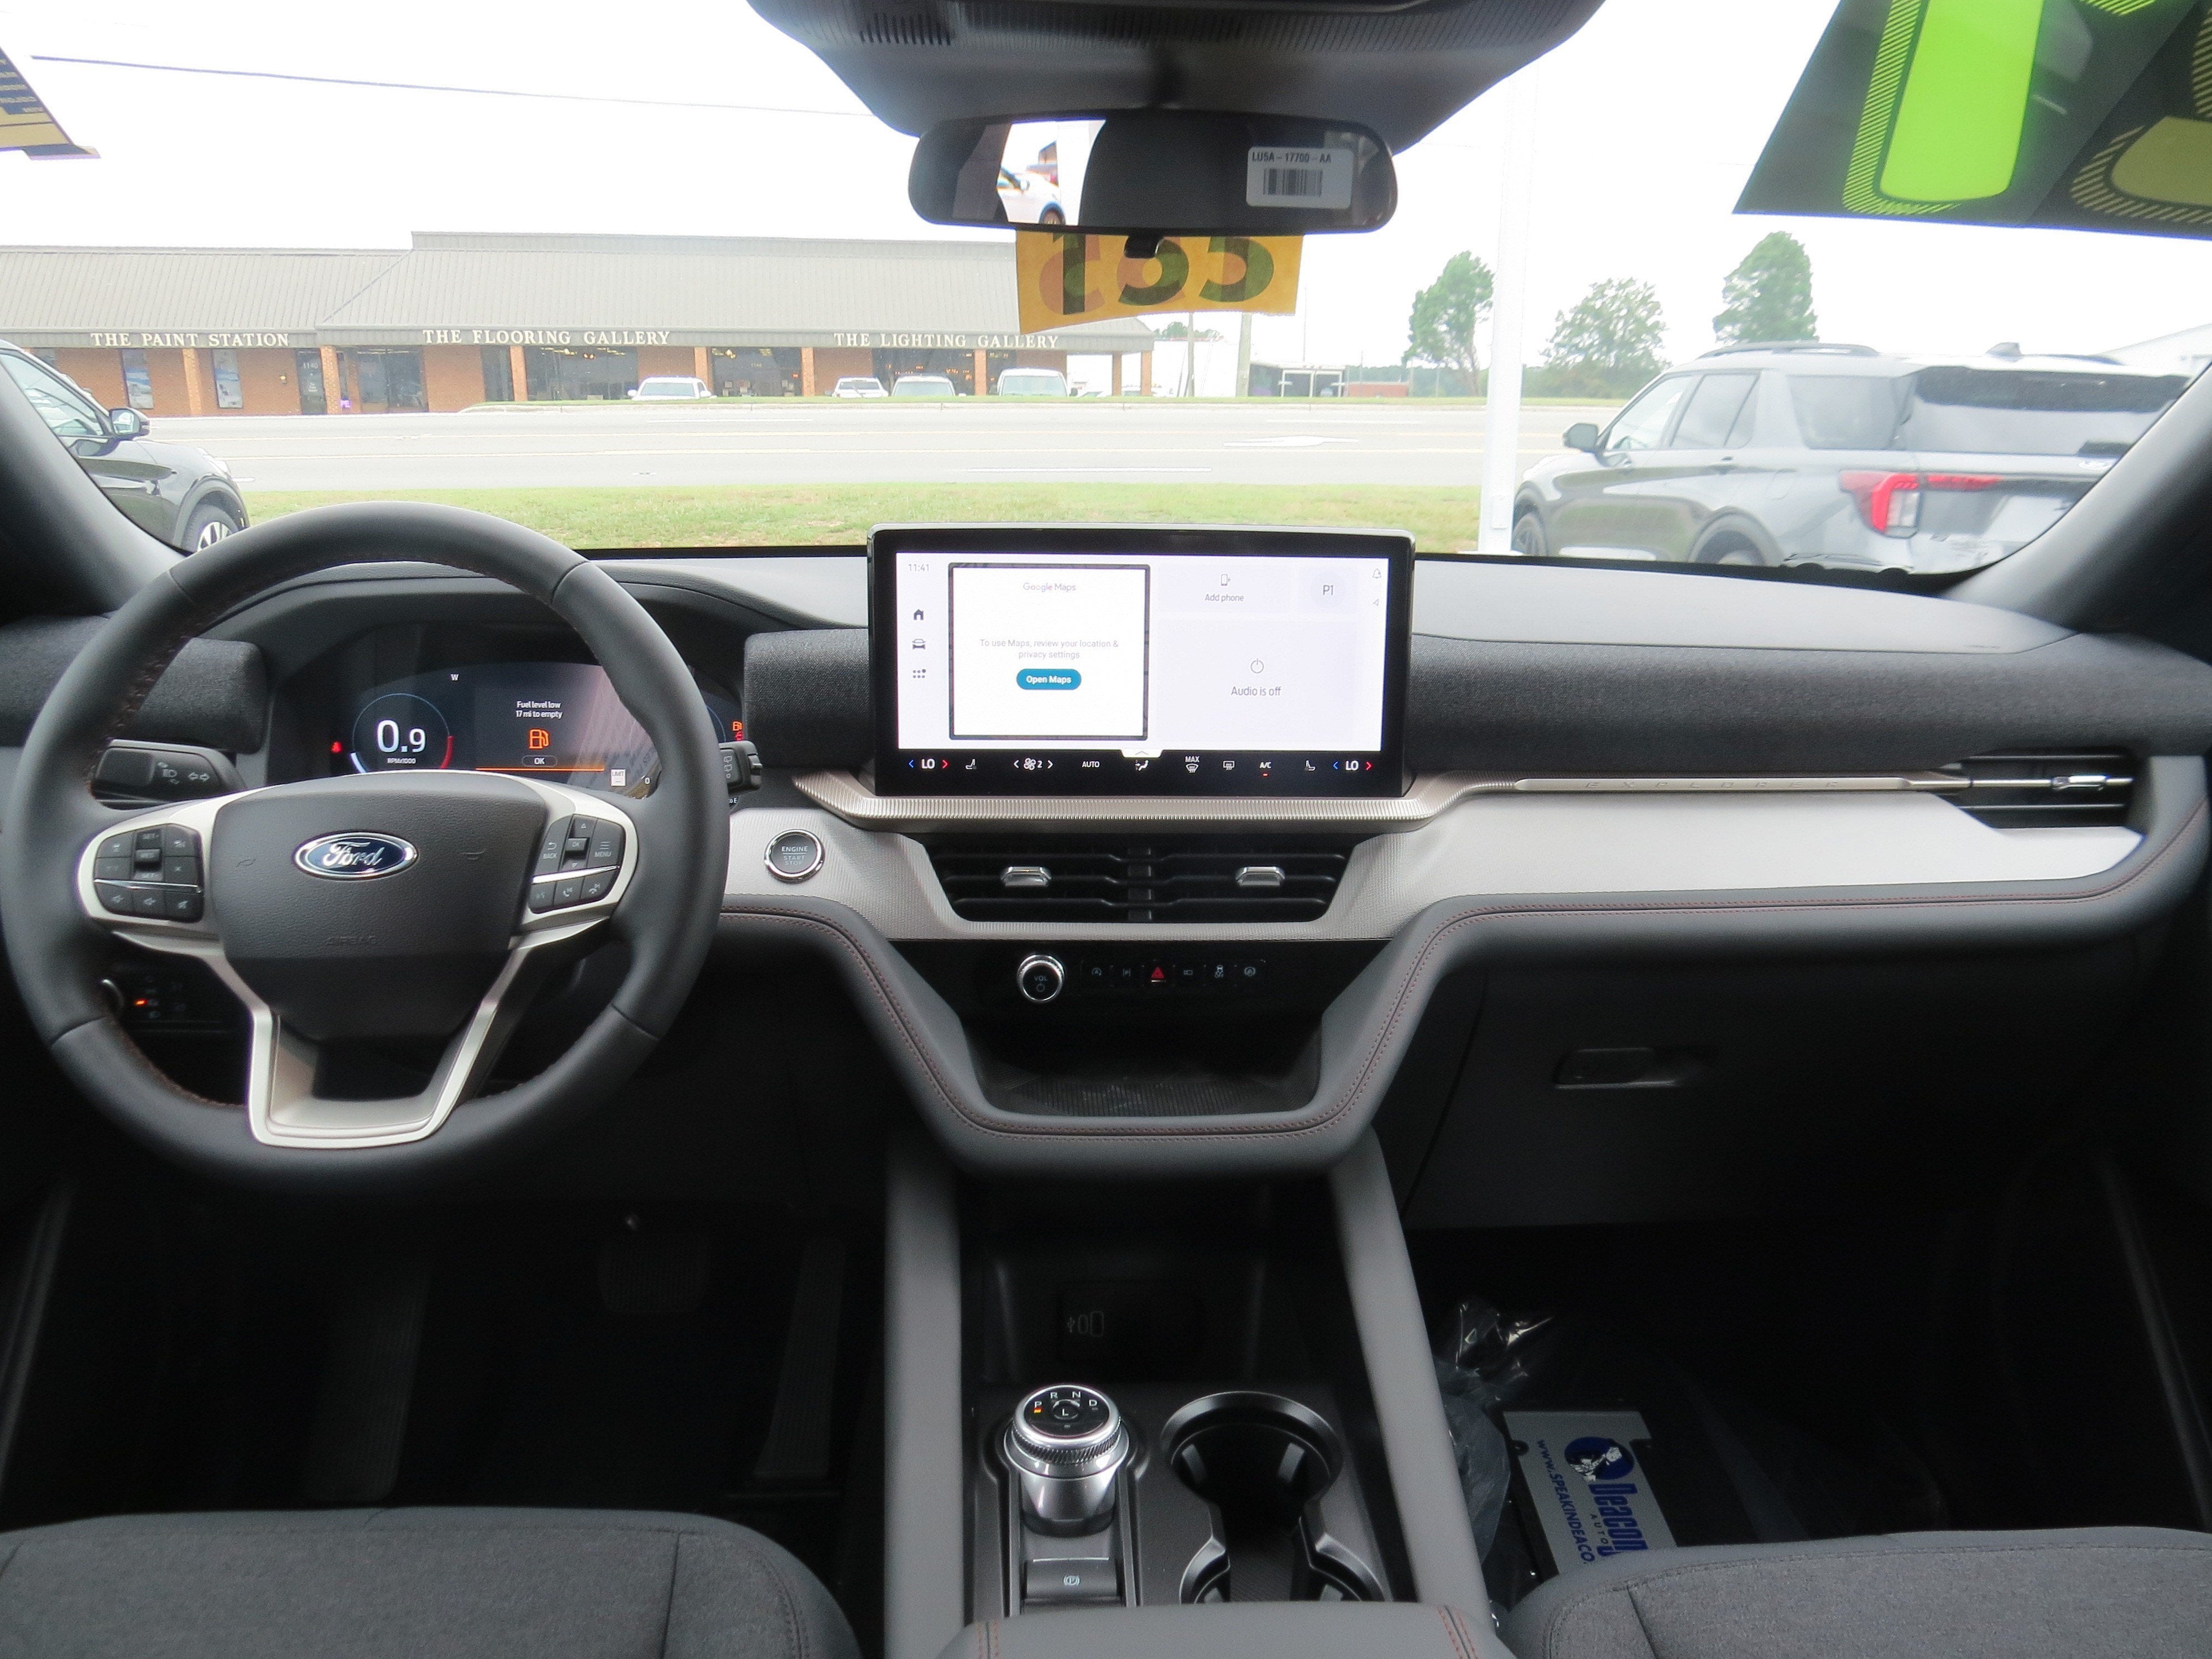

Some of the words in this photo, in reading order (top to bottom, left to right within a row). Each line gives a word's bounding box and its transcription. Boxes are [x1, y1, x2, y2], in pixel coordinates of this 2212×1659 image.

[90, 333, 132, 346] THE
[142, 333, 199, 347] PAINT
[208, 333, 289, 347] STATION
[422, 329, 462, 343] THE
[473, 330, 571, 345] FLOORING
[583, 331, 671, 345] GALLERY
[833, 333, 870, 347] THE
[880, 333, 967, 348] LIGHTING
[977, 335, 1059, 348] GALLERY
[907, 563, 930, 572] 11:41
[1022, 582, 1052, 593] Google
[1054, 583, 1077, 593] Maps
[1322, 585, 1334, 596] P1
[1204, 594, 1220, 602] Add
[1221, 594, 1244, 603] phone
[1008, 639, 1032, 648] Maps,
[1018, 651, 1047, 660] privacy
[1048, 651, 1080, 660] settings
[1026, 675, 1048, 685] Open
[1049, 675, 1072, 685] Maps
[1231, 686, 1259, 696] Audio
[1260, 686, 1267, 696] is
[1269, 686, 1281, 696] off
[377, 719, 426, 753] 0.9
[921, 758, 935, 769] LO
[1037, 760, 1042, 768] 2
[1260, 761, 1271, 769] A/C
[1345, 760, 1358, 771] LO
[323, 841, 385, 866] Ford
[1062, 1408, 1068, 1417] L
[1588, 1483, 1648, 1550] Deacon
[1590, 1514, 1609, 1545] AUTO
